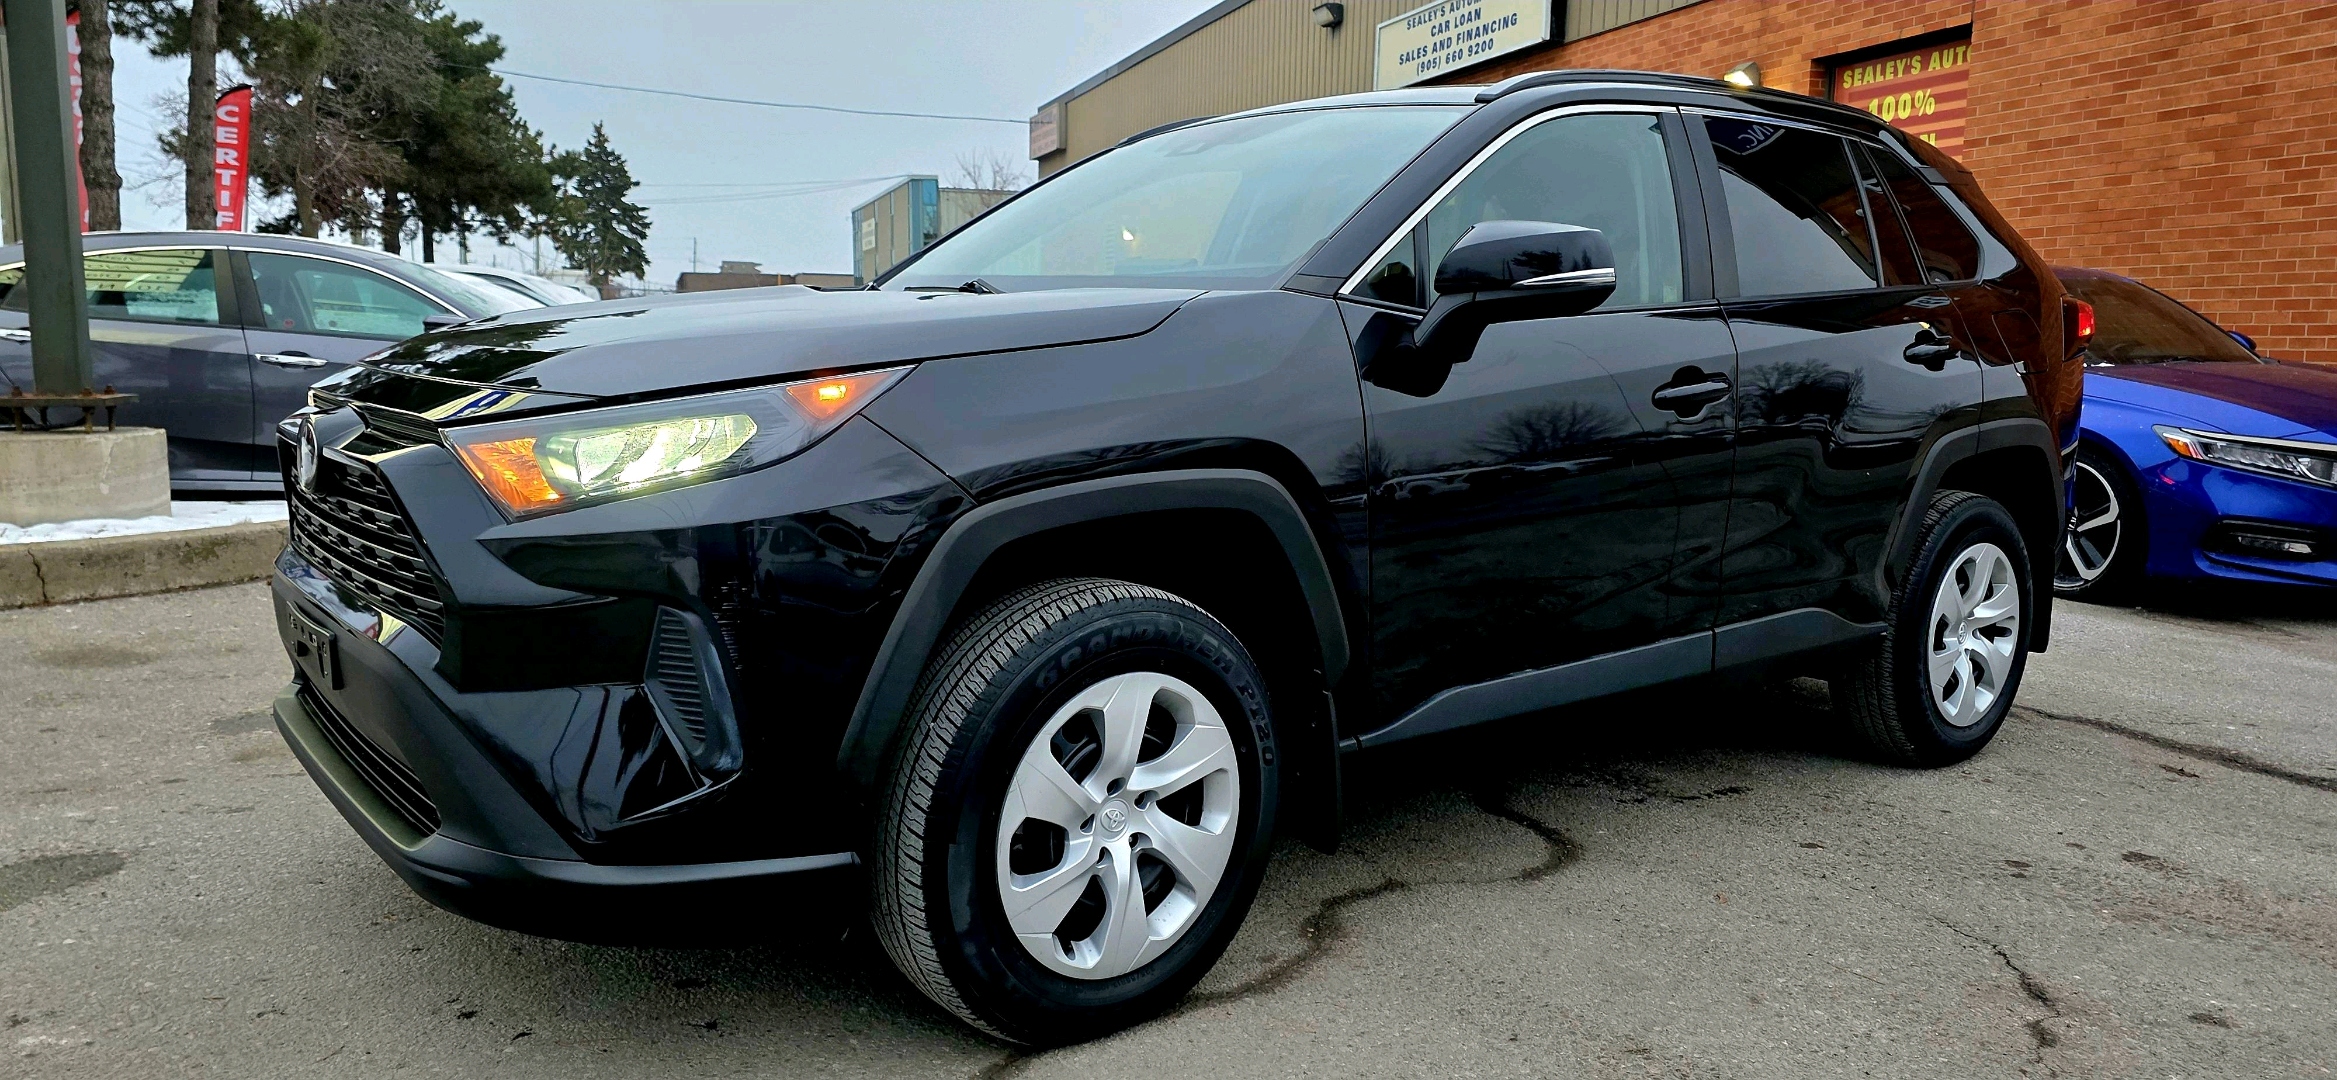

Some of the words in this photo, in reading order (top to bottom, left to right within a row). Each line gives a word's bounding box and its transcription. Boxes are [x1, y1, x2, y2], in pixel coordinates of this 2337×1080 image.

[1406, 5, 1446, 31] SEALEY'S
[1431, 19, 1450, 37] CAR
[1454, 7, 1482, 29] LOAN
[1399, 46, 1428, 66] SALES
[1432, 37, 1453, 55] AND
[1456, 12, 1518, 45] FINANCING
[1416, 55, 1442, 76] (905)
[1445, 48, 1464, 65] 660
[1467, 38, 1494, 57] 9200
[1842, 55, 1922, 89] SEALEY'S
[1868, 89, 1936, 123] 100%
